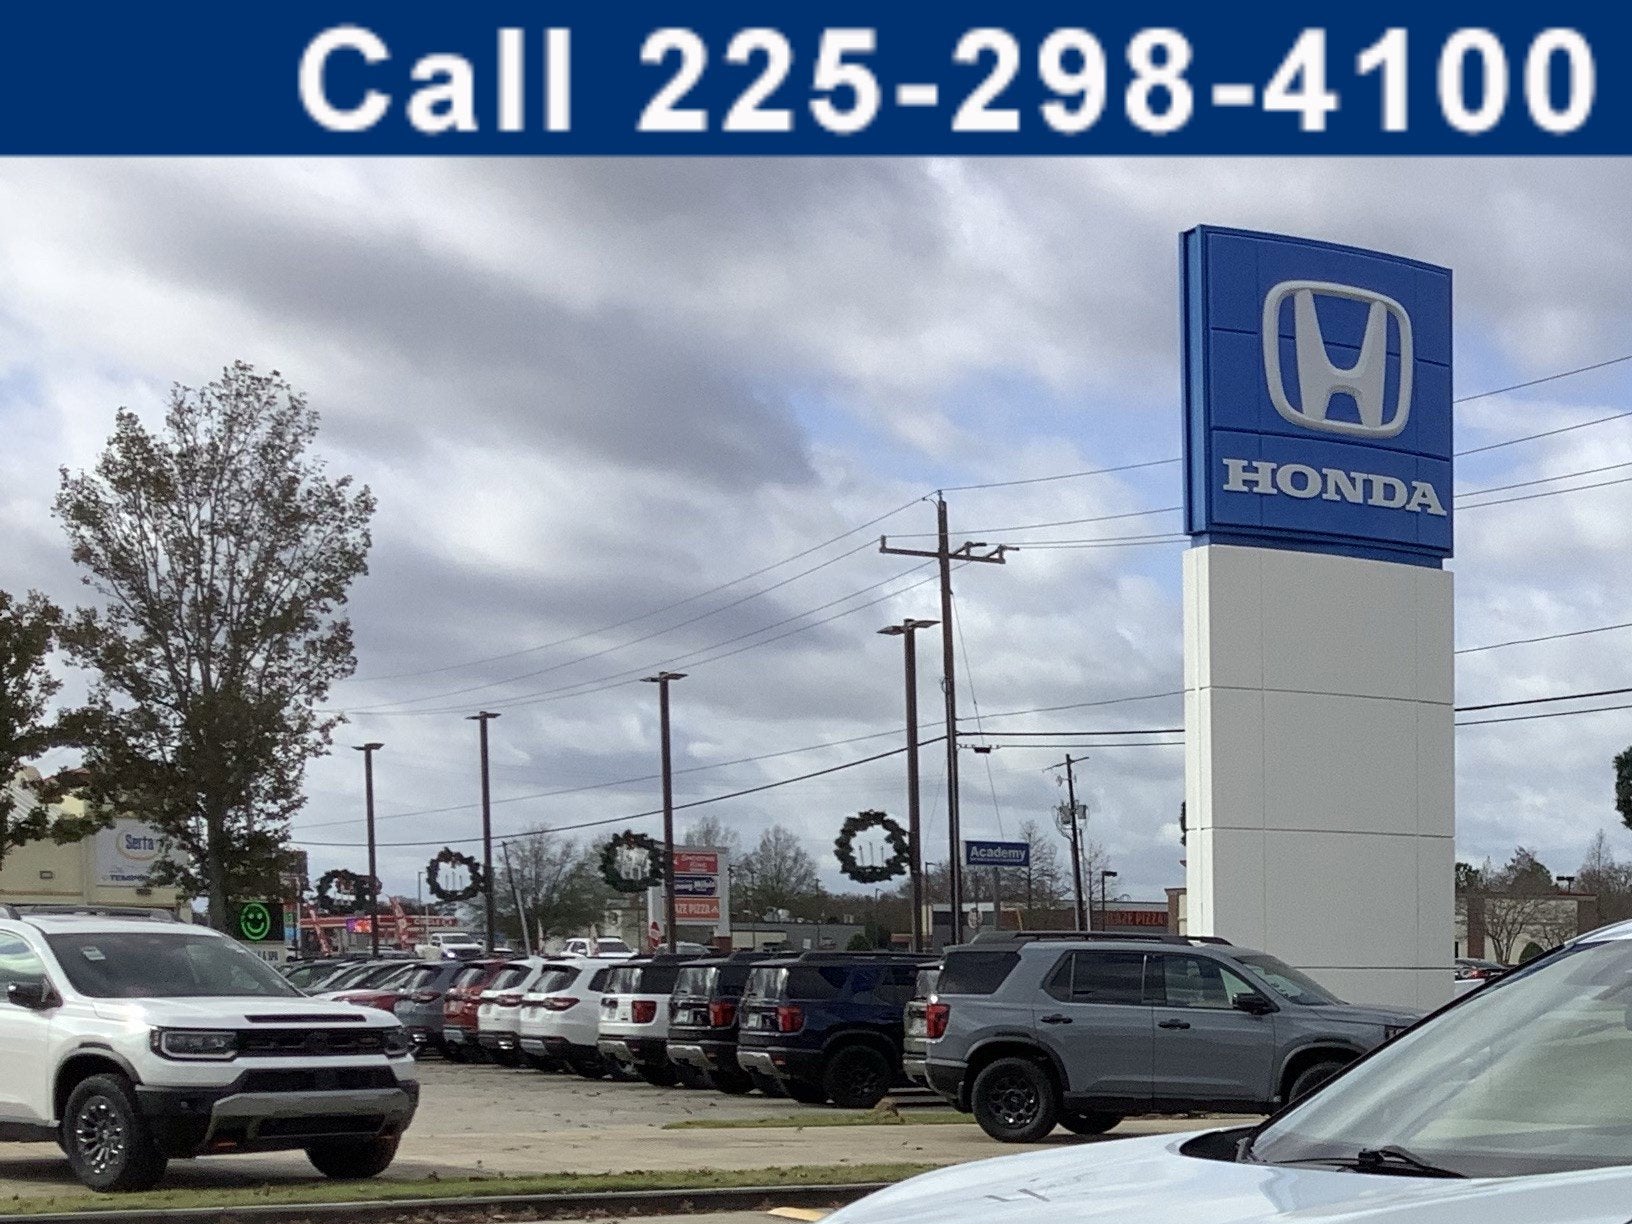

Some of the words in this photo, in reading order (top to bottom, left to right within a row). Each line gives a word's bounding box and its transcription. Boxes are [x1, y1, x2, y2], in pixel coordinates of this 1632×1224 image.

[1222, 457, 1447, 516] HONDA
[125, 834, 154, 850] Serta
[971, 845, 1026, 862] Academy
[689, 903, 711, 915] PIZZA
[1135, 911, 1164, 926] PIZZA
